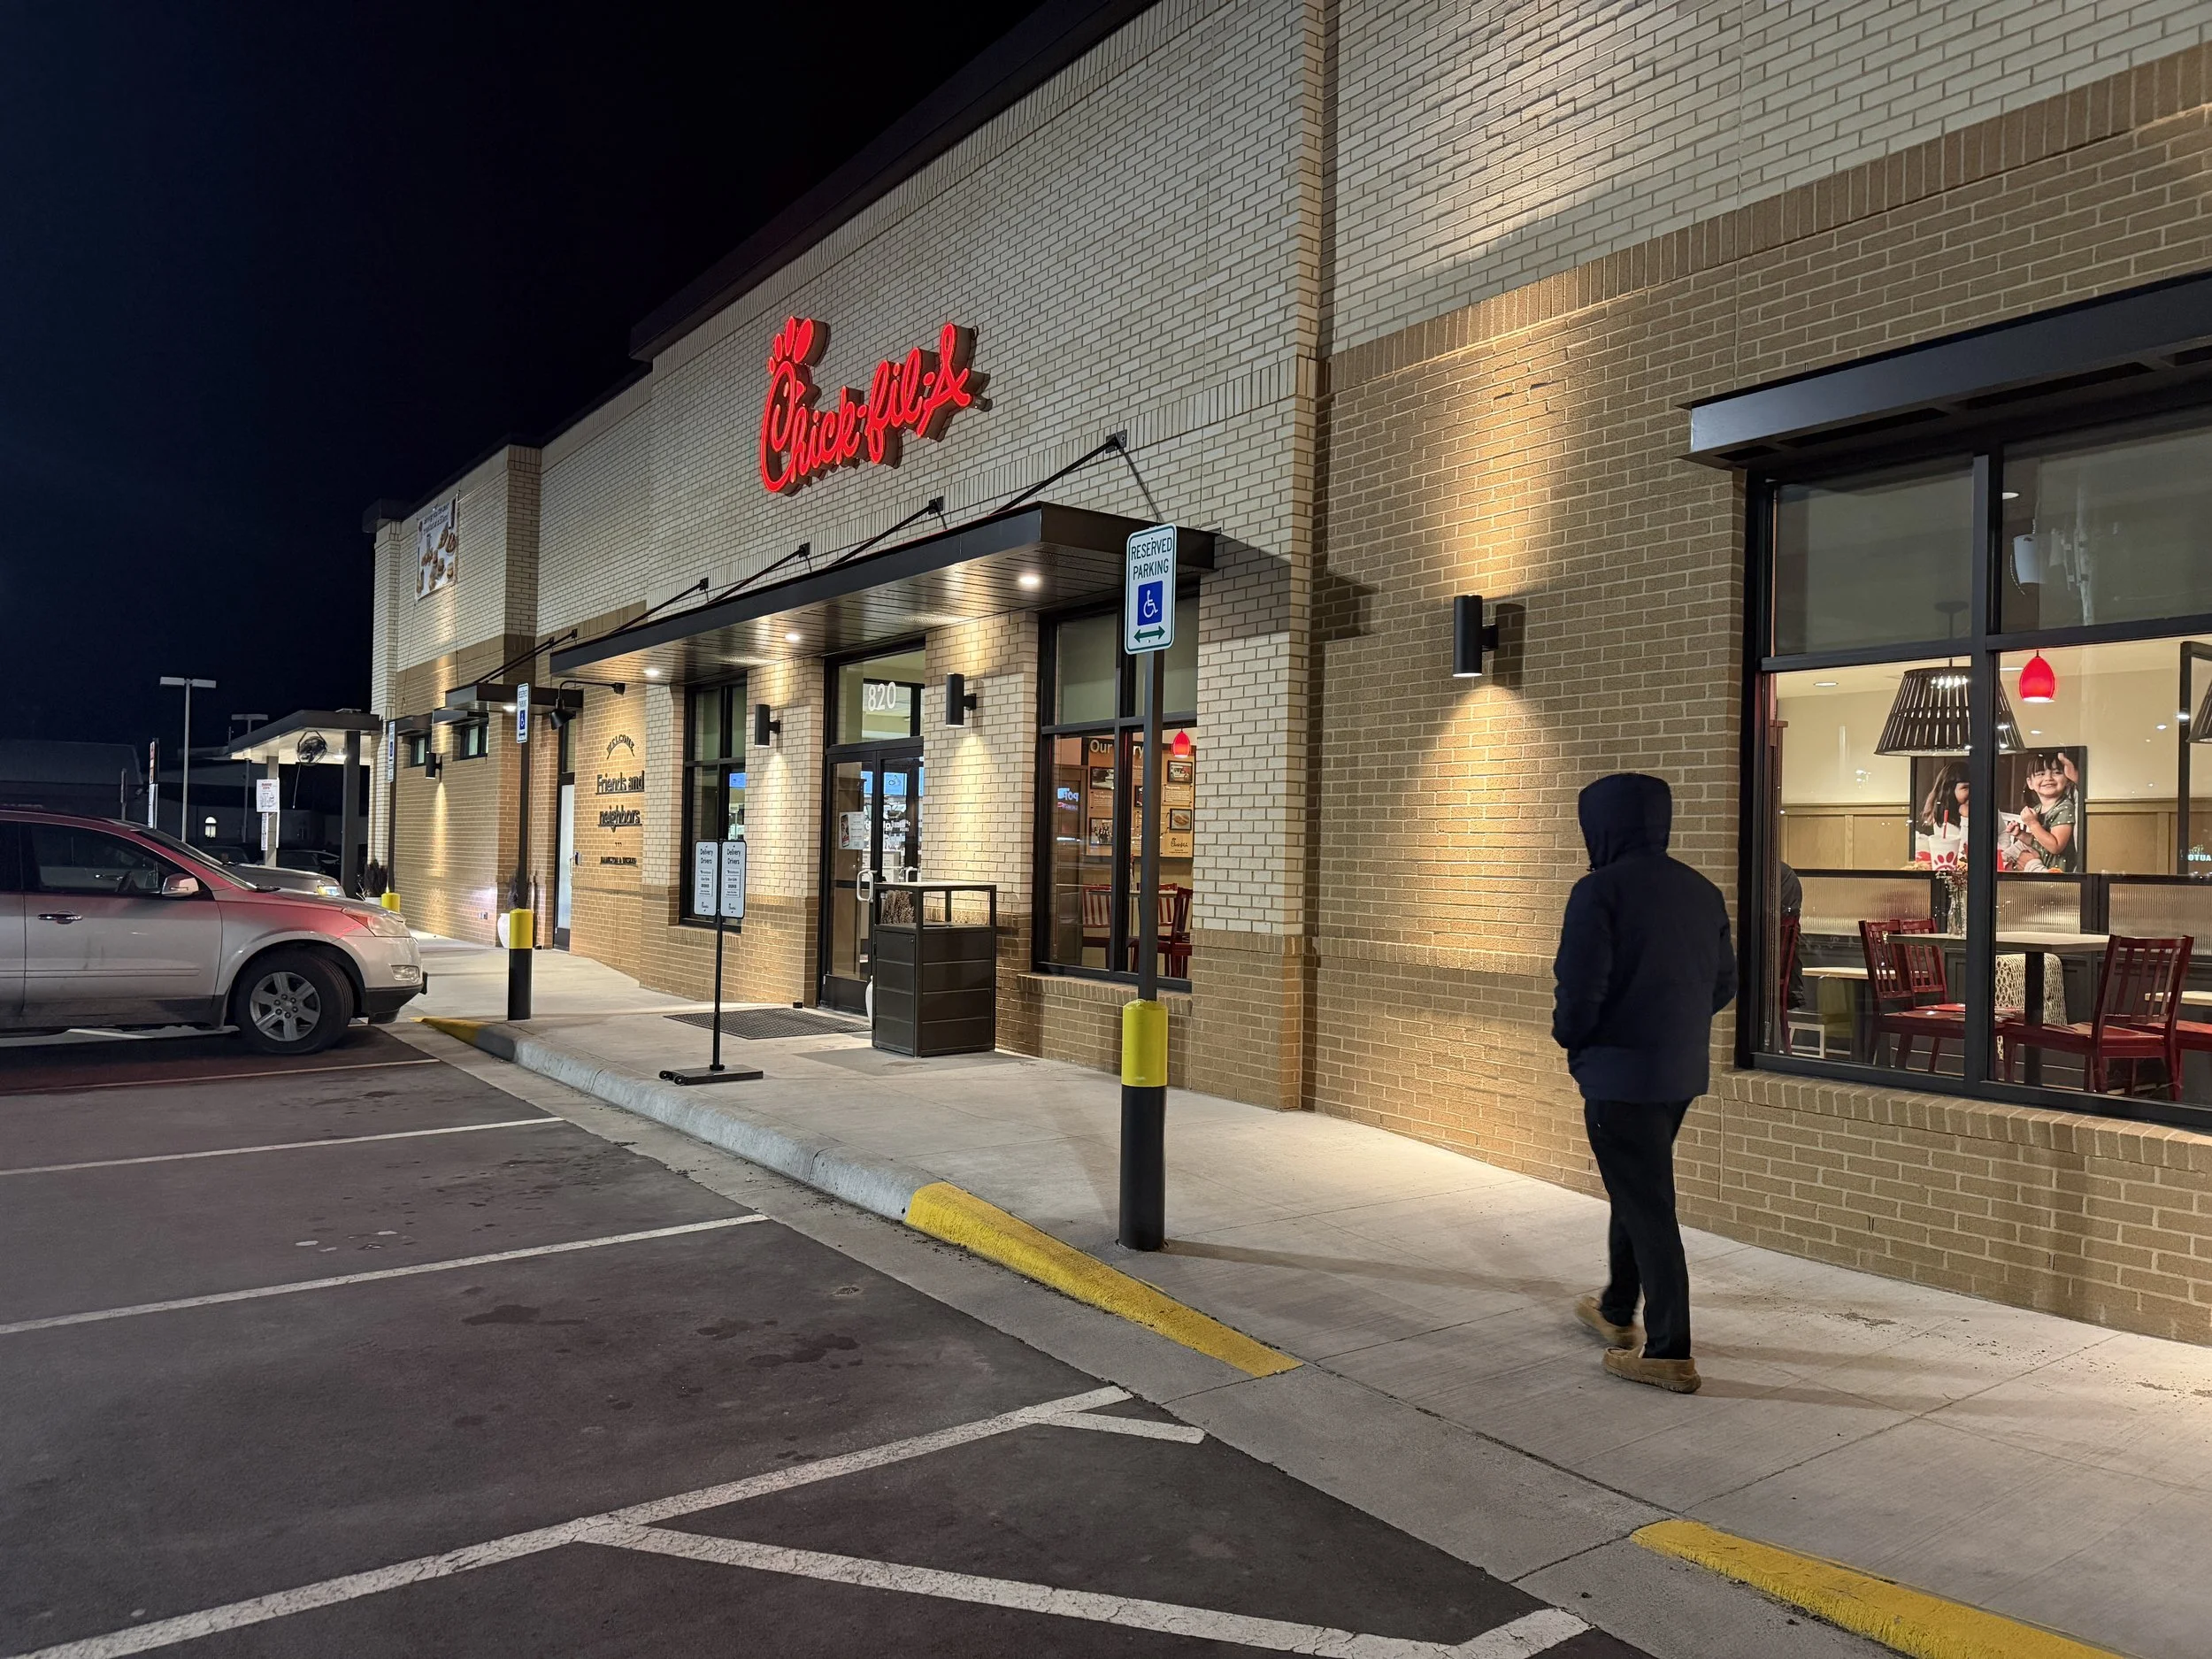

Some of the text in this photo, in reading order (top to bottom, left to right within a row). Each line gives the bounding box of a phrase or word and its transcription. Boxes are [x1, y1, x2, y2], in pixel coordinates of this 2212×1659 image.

[761, 319, 972, 492] Chick-fil-A
[1131, 537, 1172, 561] RESERVED
[1133, 558, 1169, 580] PARKING
[868, 681, 896, 711] 820
[1090, 739, 1113, 754] Our
[596, 770, 645, 794] Friends and
[599, 804, 641, 833] neighbors
[700, 848, 713, 856] Delivery
[726, 848, 741, 857] Delivery
